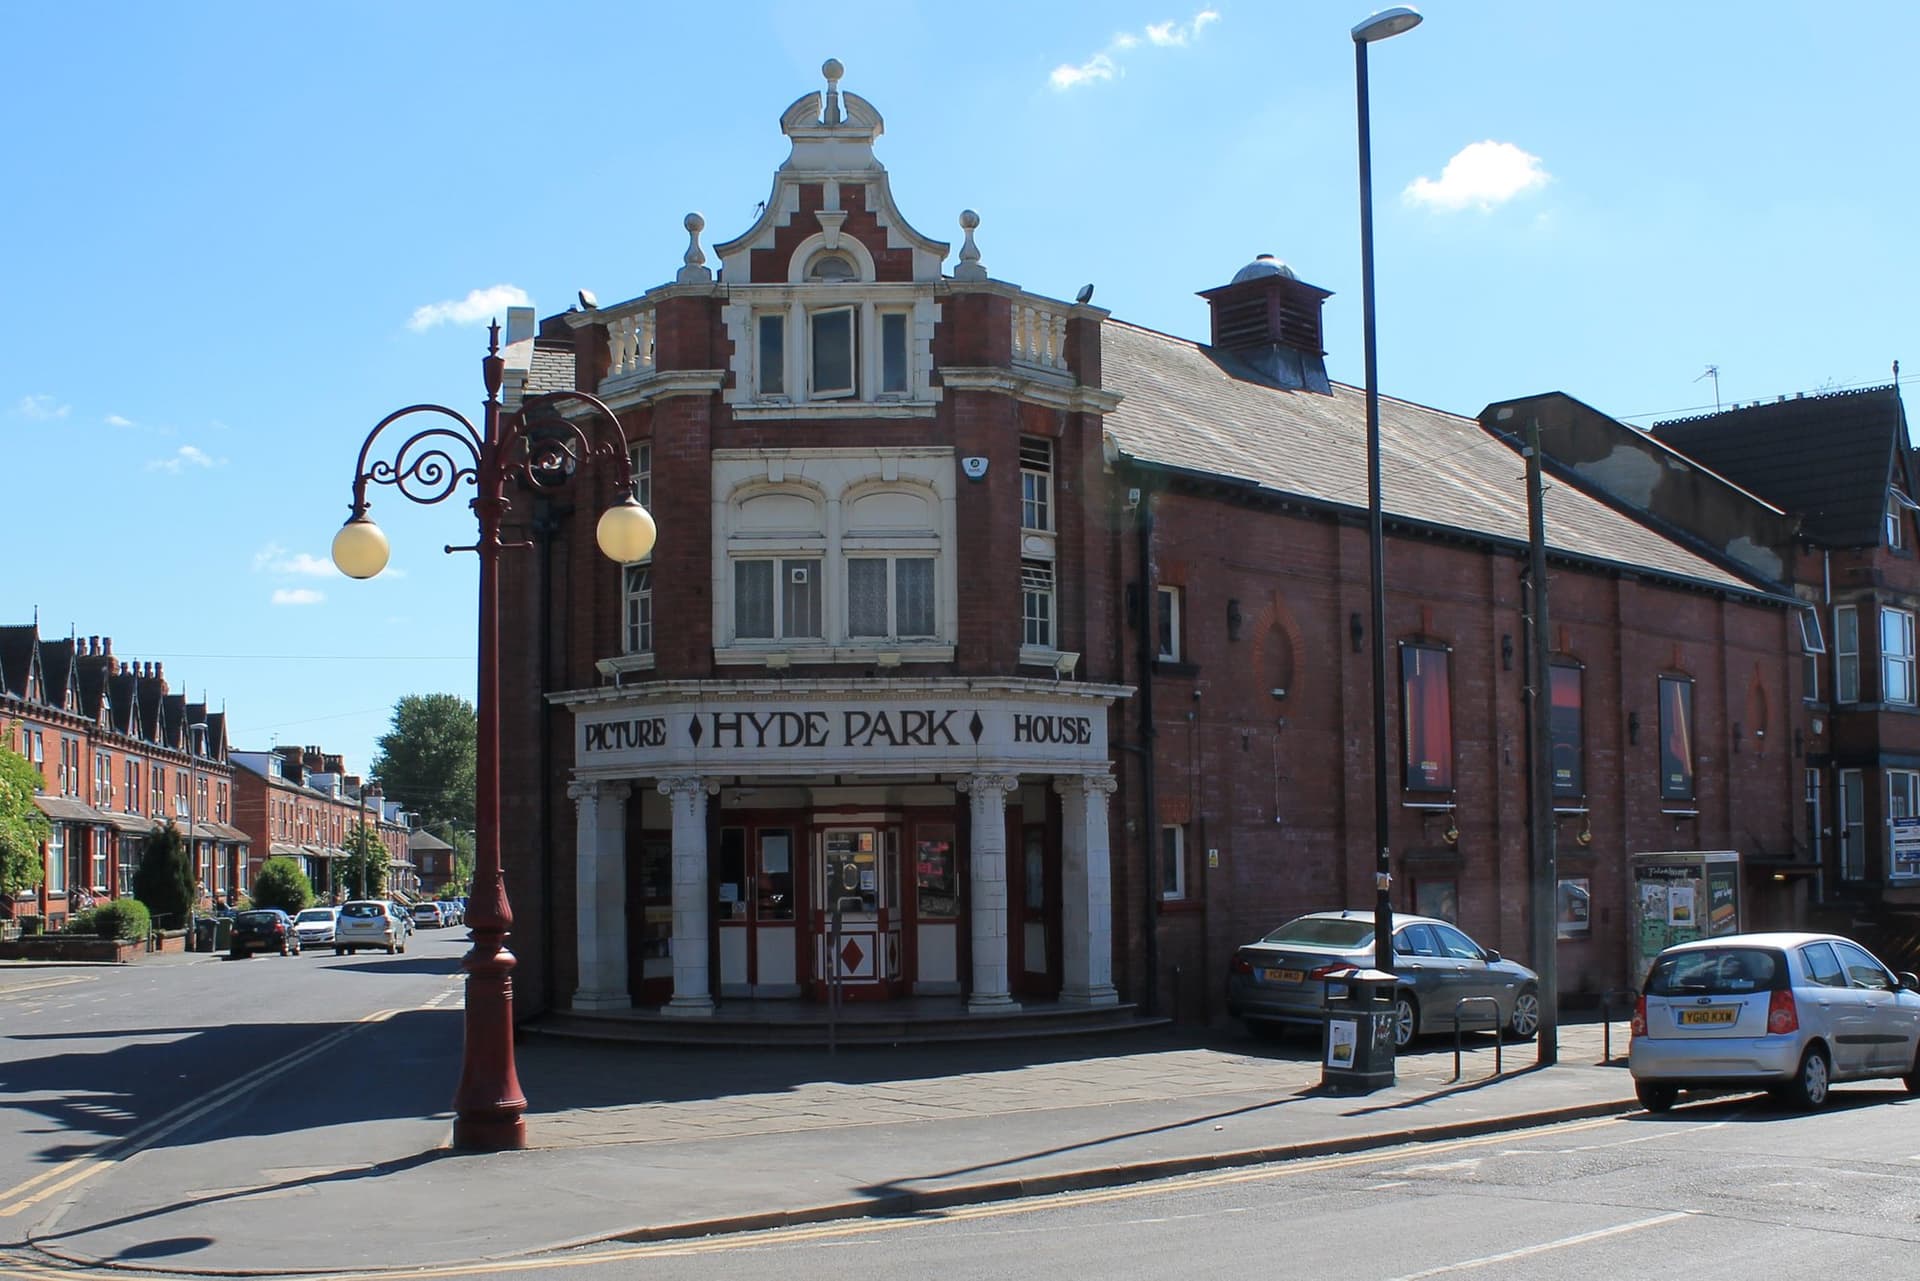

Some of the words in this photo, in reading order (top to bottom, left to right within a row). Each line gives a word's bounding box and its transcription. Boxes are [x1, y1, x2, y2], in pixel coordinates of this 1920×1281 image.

[585, 718, 667, 751] PICTURE
[712, 711, 829, 748] HYDE
[843, 710, 960, 747] PARK
[1013, 713, 1092, 745] HOUSE
